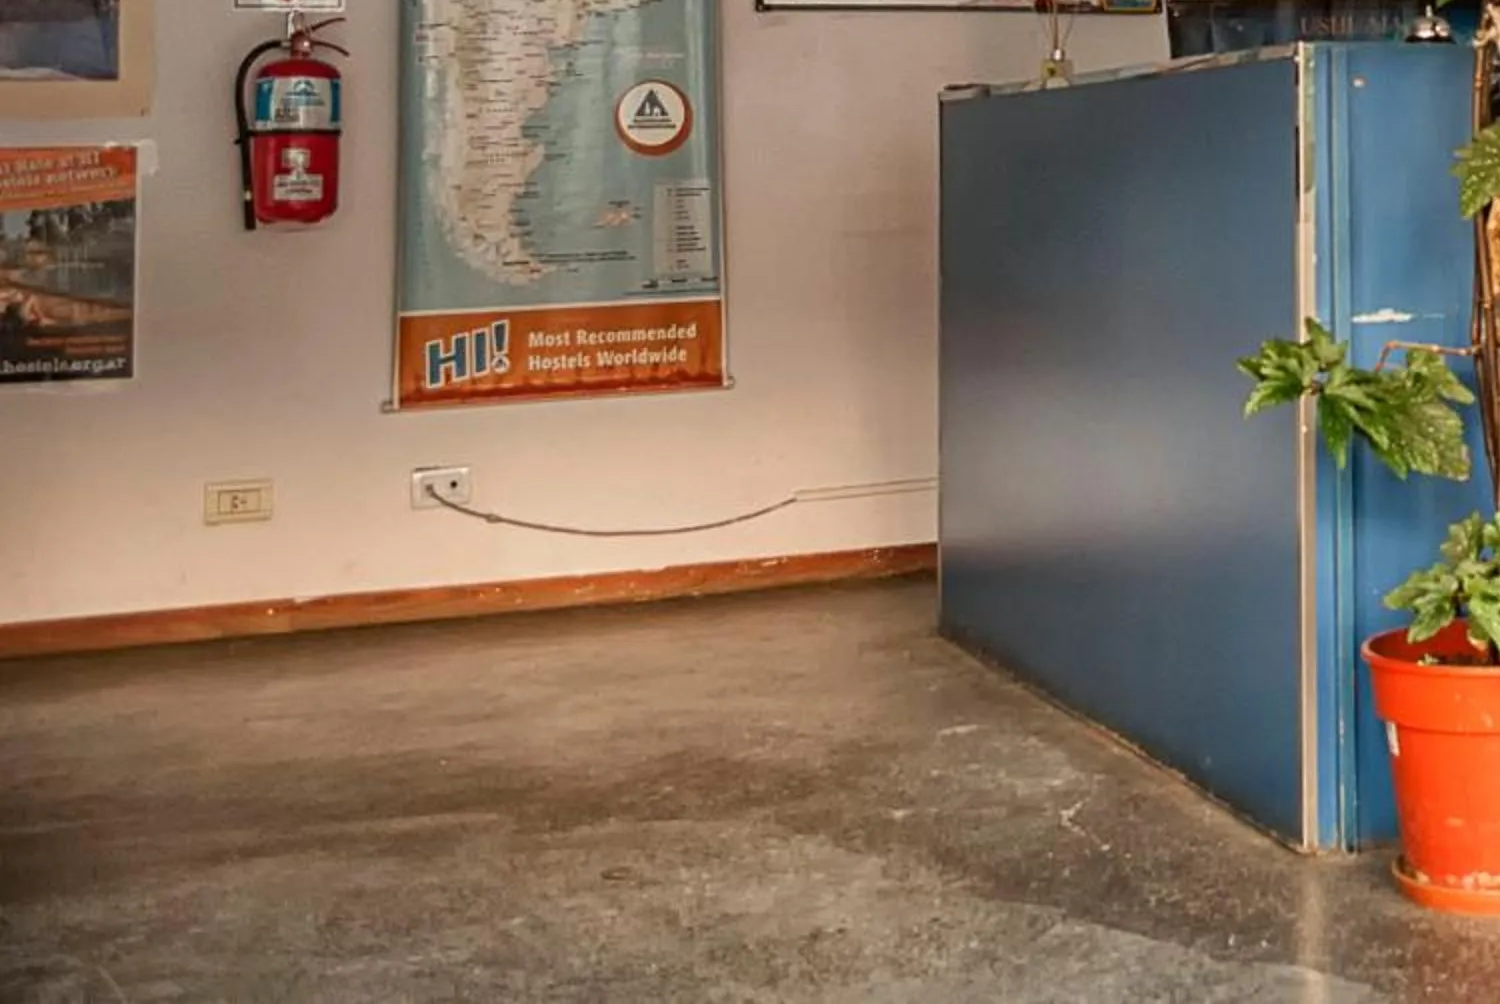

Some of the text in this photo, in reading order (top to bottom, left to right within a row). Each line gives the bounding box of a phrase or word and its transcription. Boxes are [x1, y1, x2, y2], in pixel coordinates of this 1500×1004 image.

[528, 322, 698, 347] Most Recommended
[424, 319, 510, 389] HI!
[528, 345, 688, 371] Hostels Worldwide
